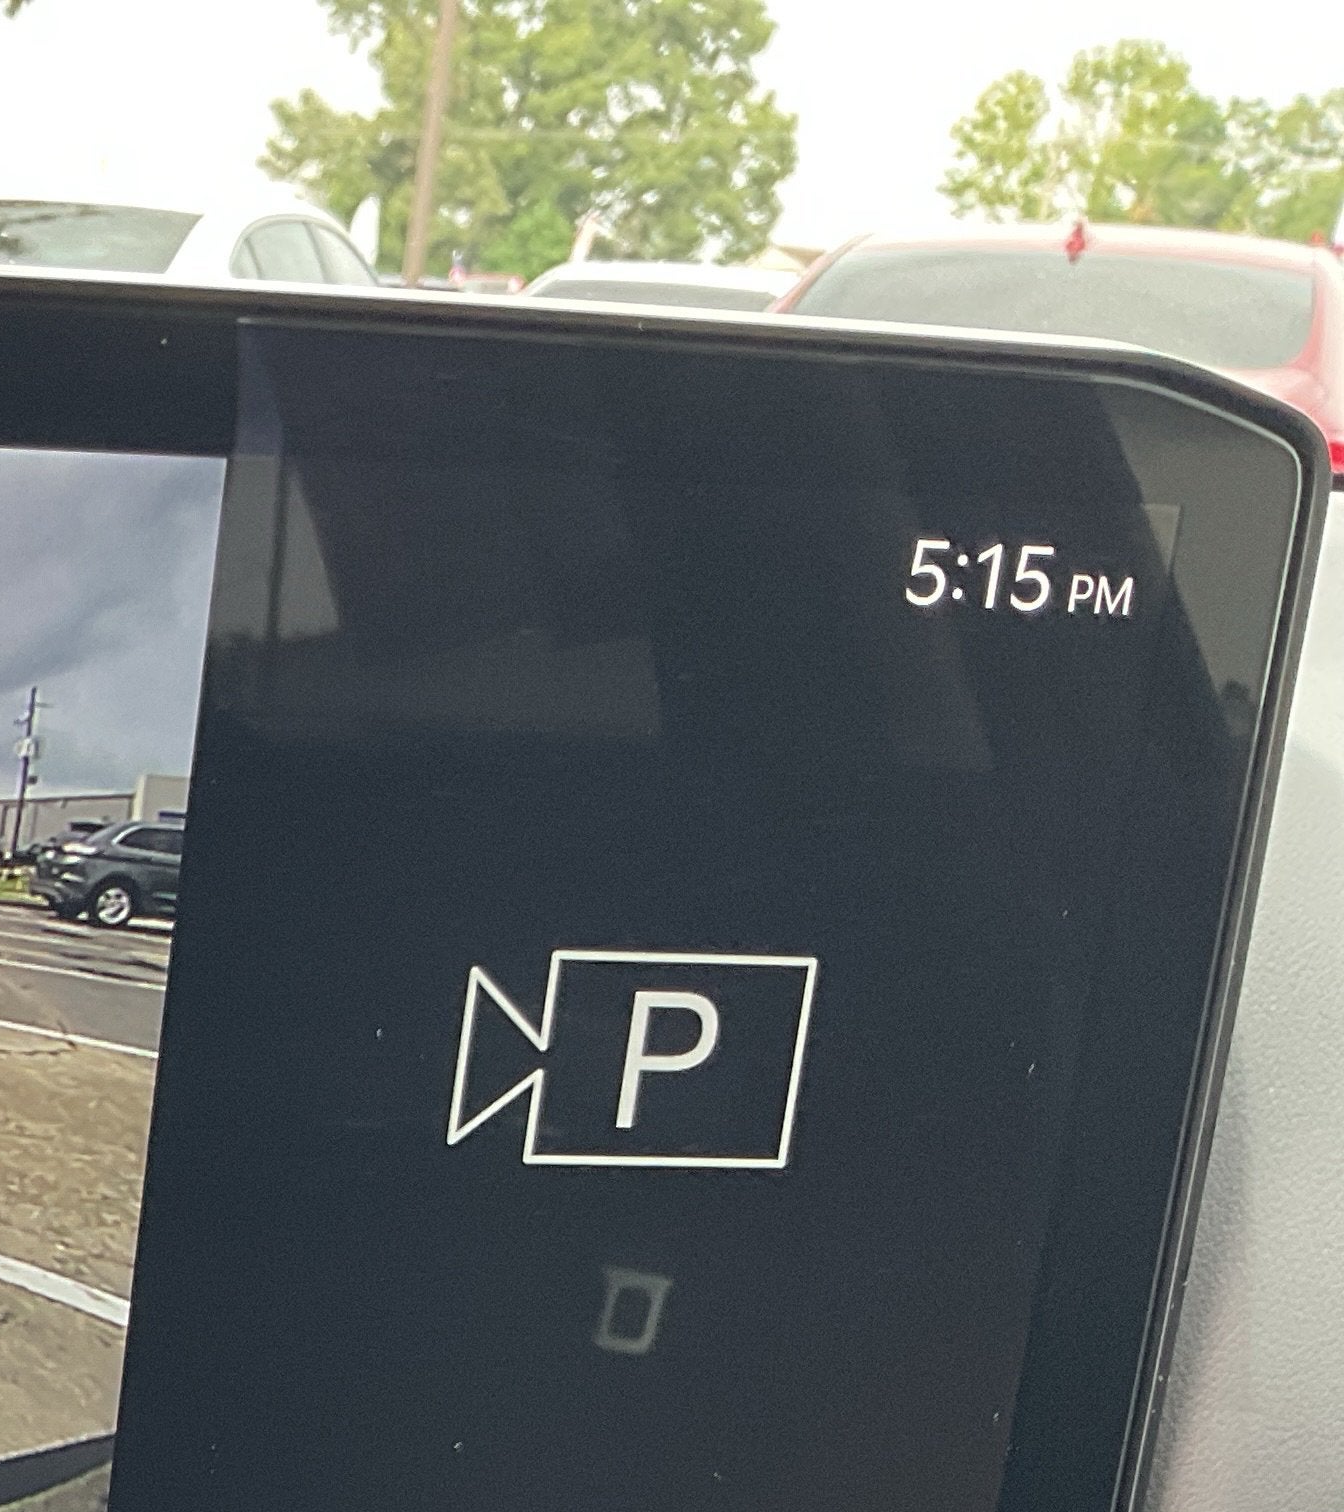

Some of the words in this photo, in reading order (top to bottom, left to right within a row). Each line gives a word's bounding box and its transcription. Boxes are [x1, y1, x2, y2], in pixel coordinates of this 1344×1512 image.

[905, 538, 1055, 612] 5:15
[1066, 574, 1134, 616] PM
[615, 990, 720, 1129] P
